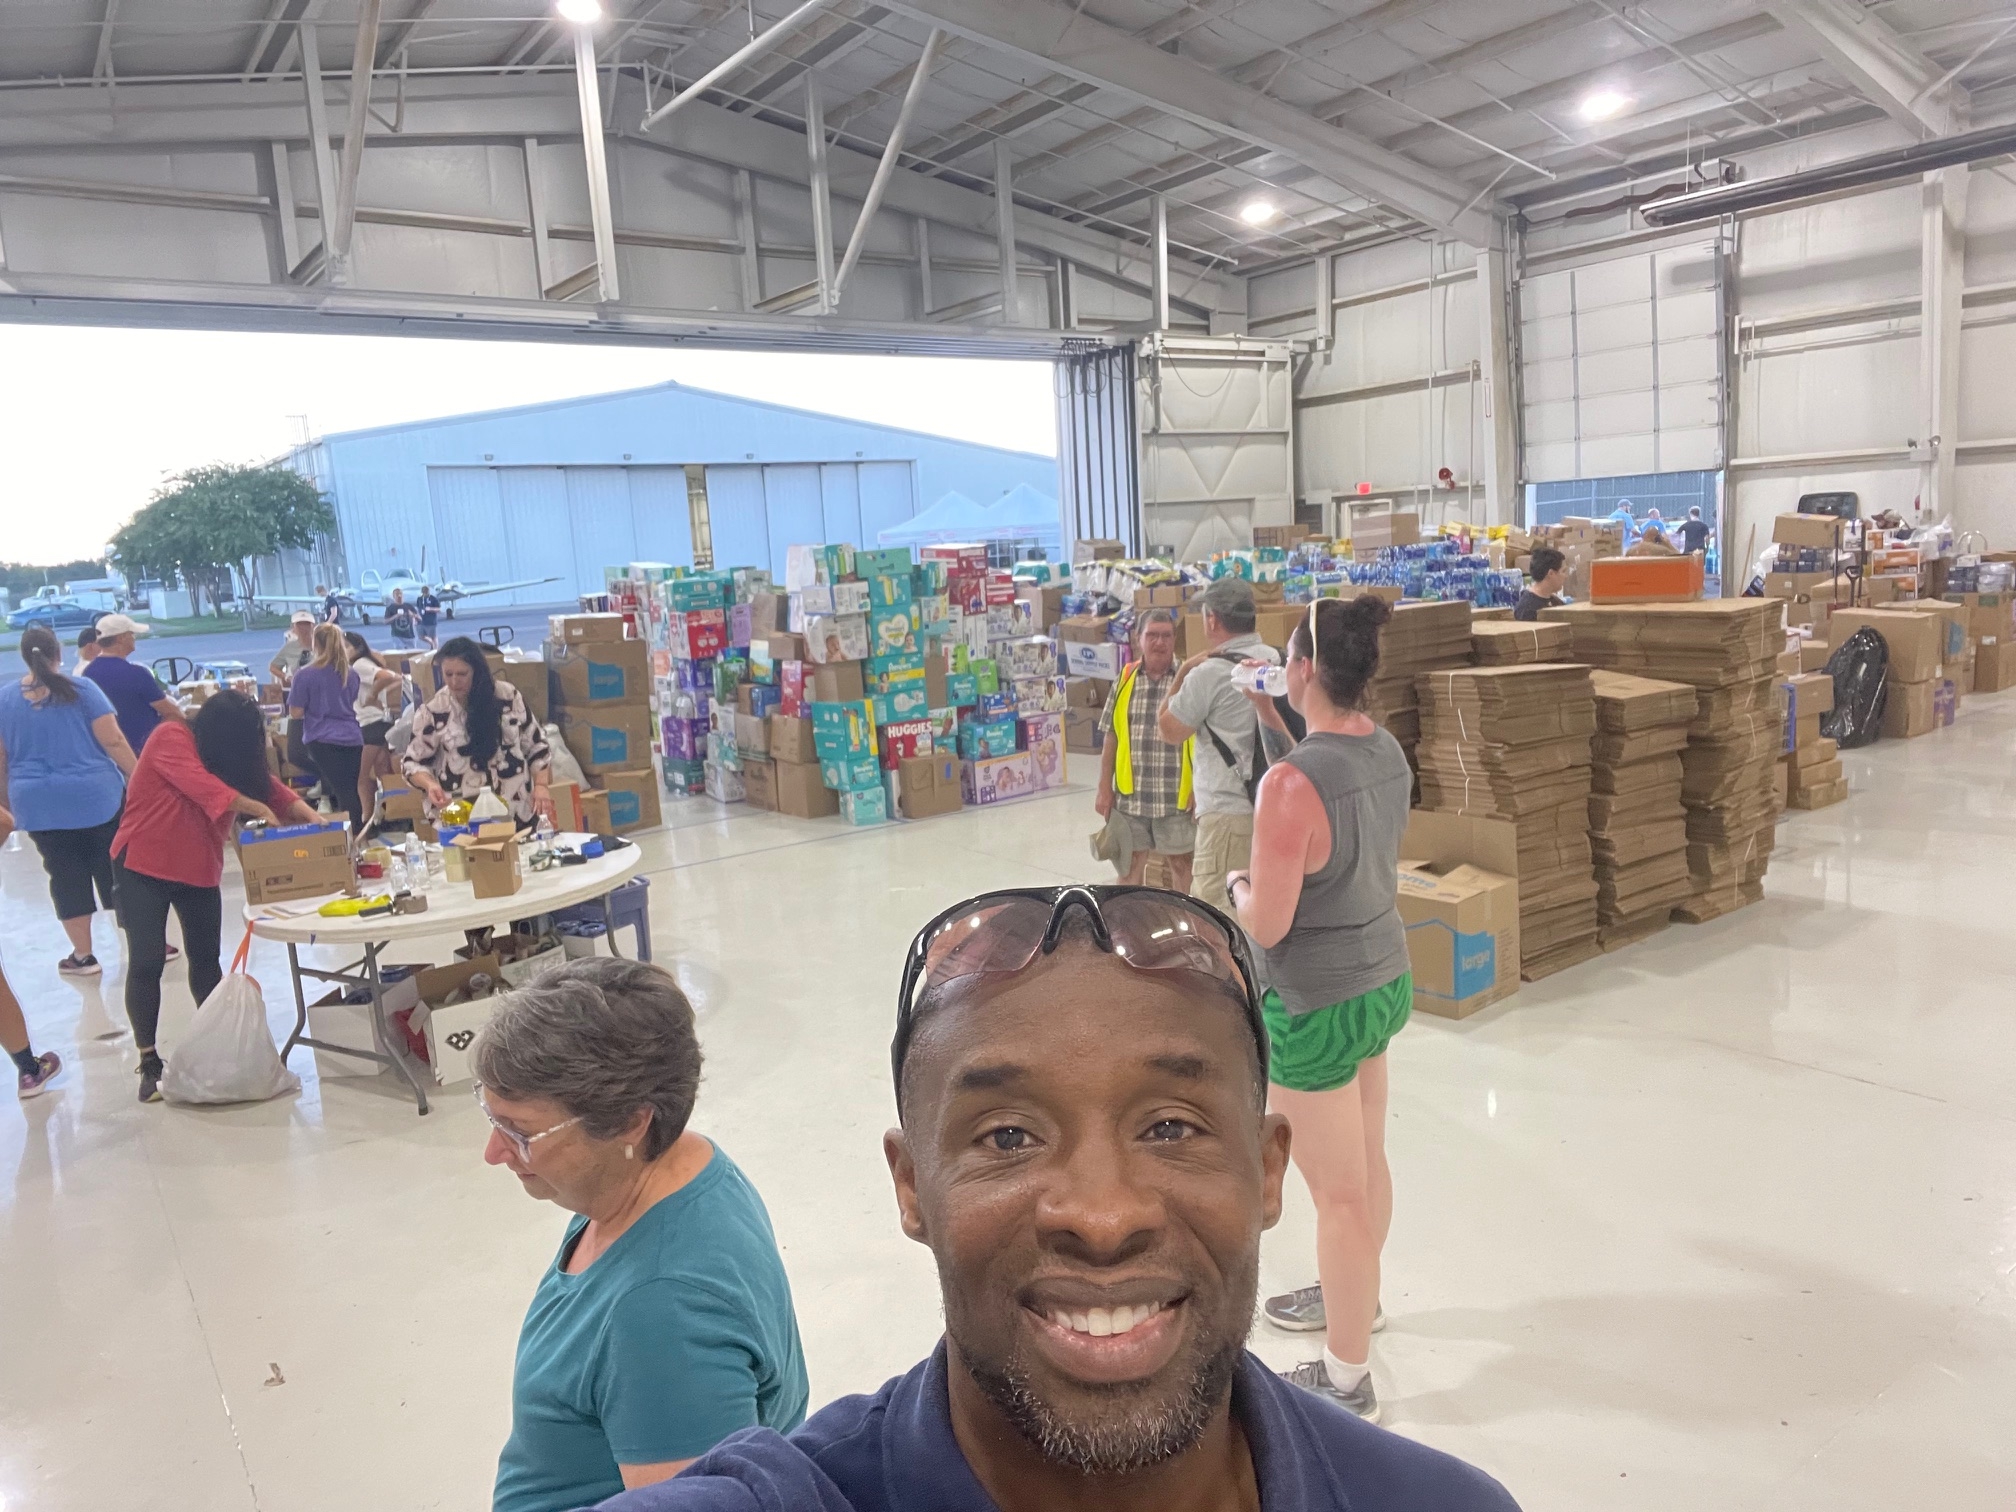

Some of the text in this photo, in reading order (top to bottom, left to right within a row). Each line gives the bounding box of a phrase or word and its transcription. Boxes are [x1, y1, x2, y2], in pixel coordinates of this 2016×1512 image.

[888, 662, 912, 672] Pampers
[887, 721, 933, 739] HUGGIES
[1461, 949, 1490, 972] large
